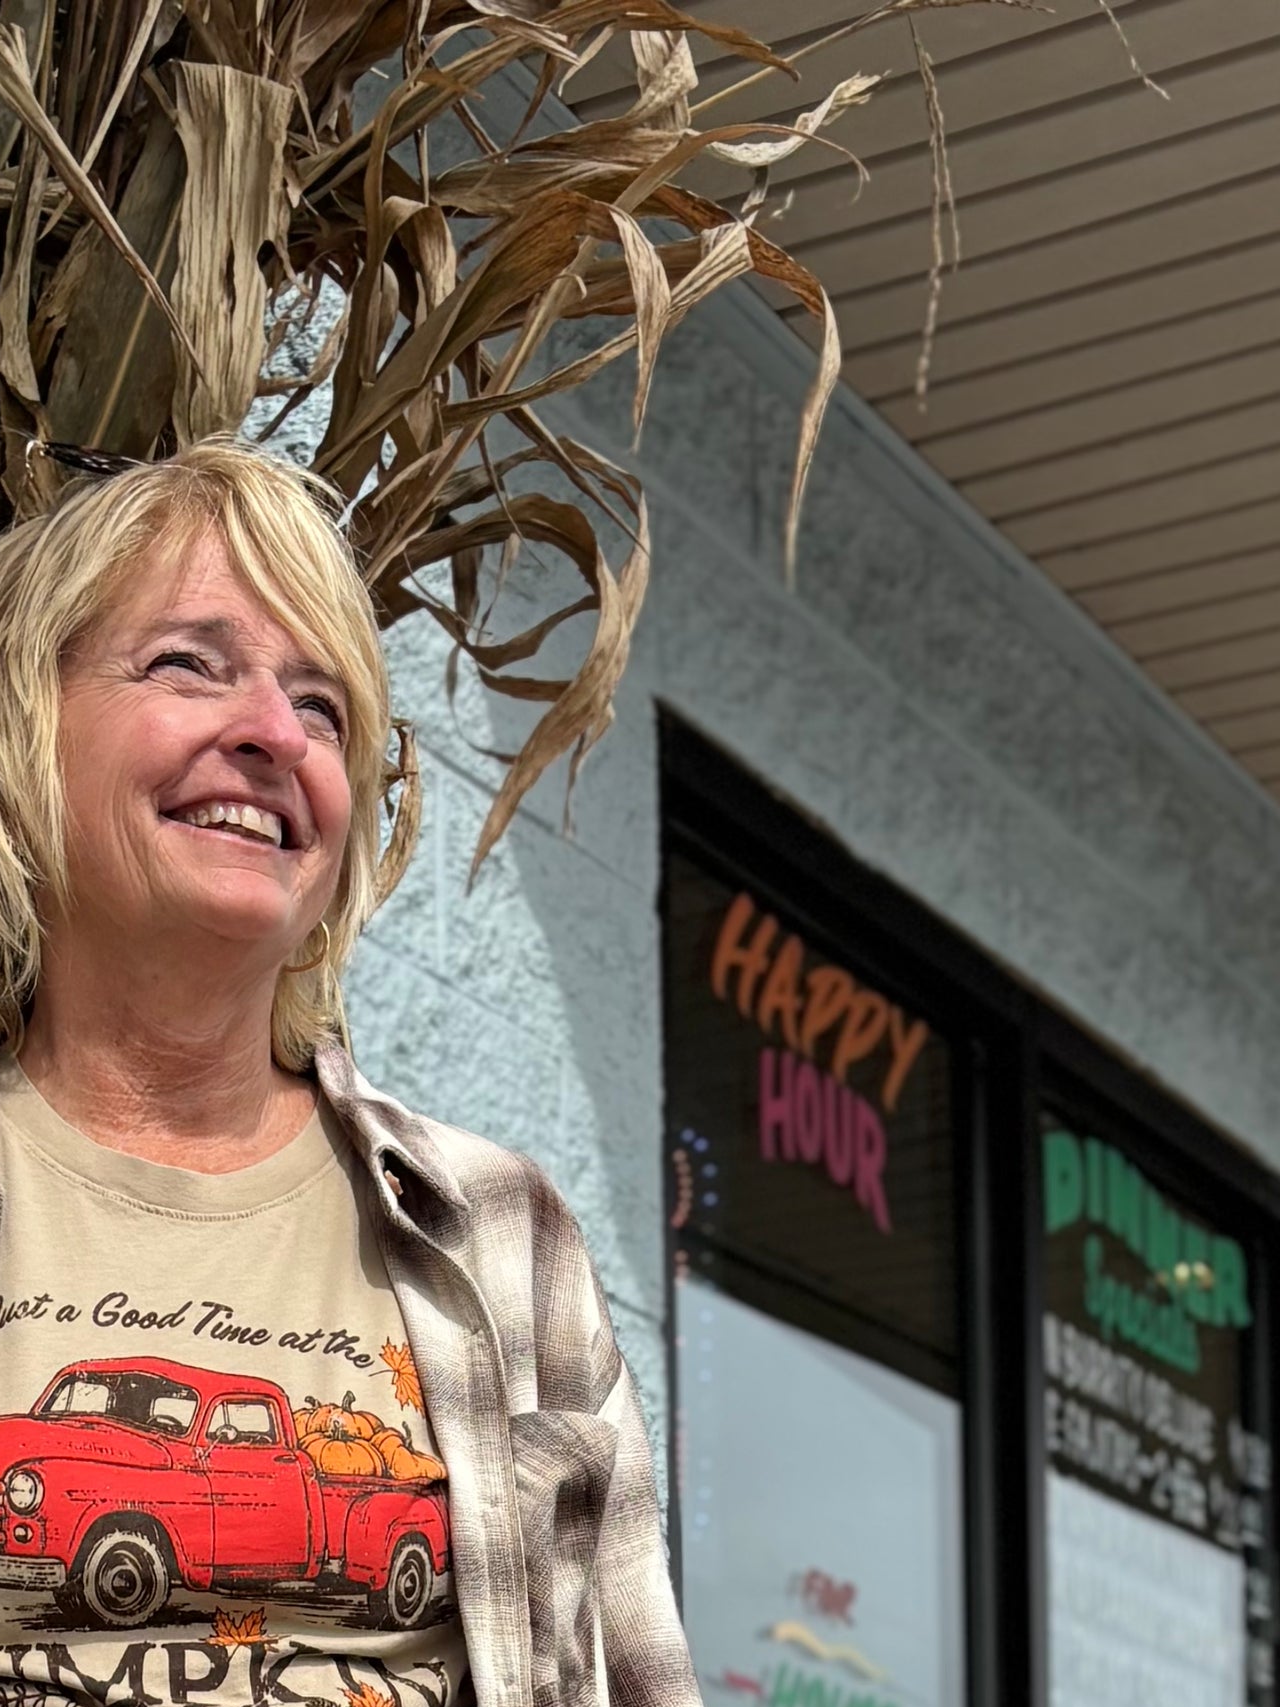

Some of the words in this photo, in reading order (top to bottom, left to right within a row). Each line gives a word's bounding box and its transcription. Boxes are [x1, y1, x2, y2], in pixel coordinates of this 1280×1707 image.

[710, 892, 930, 1114] HAPPY
[757, 1047, 892, 1235] HOUR
[1042, 1131, 1252, 1330] DINNER
[55, 1304, 82, 1323] a
[92, 1291, 193, 1330] Good
[193, 1301, 272, 1346] Time
[278, 1328, 325, 1353] at
[322, 1328, 375, 1368] the
